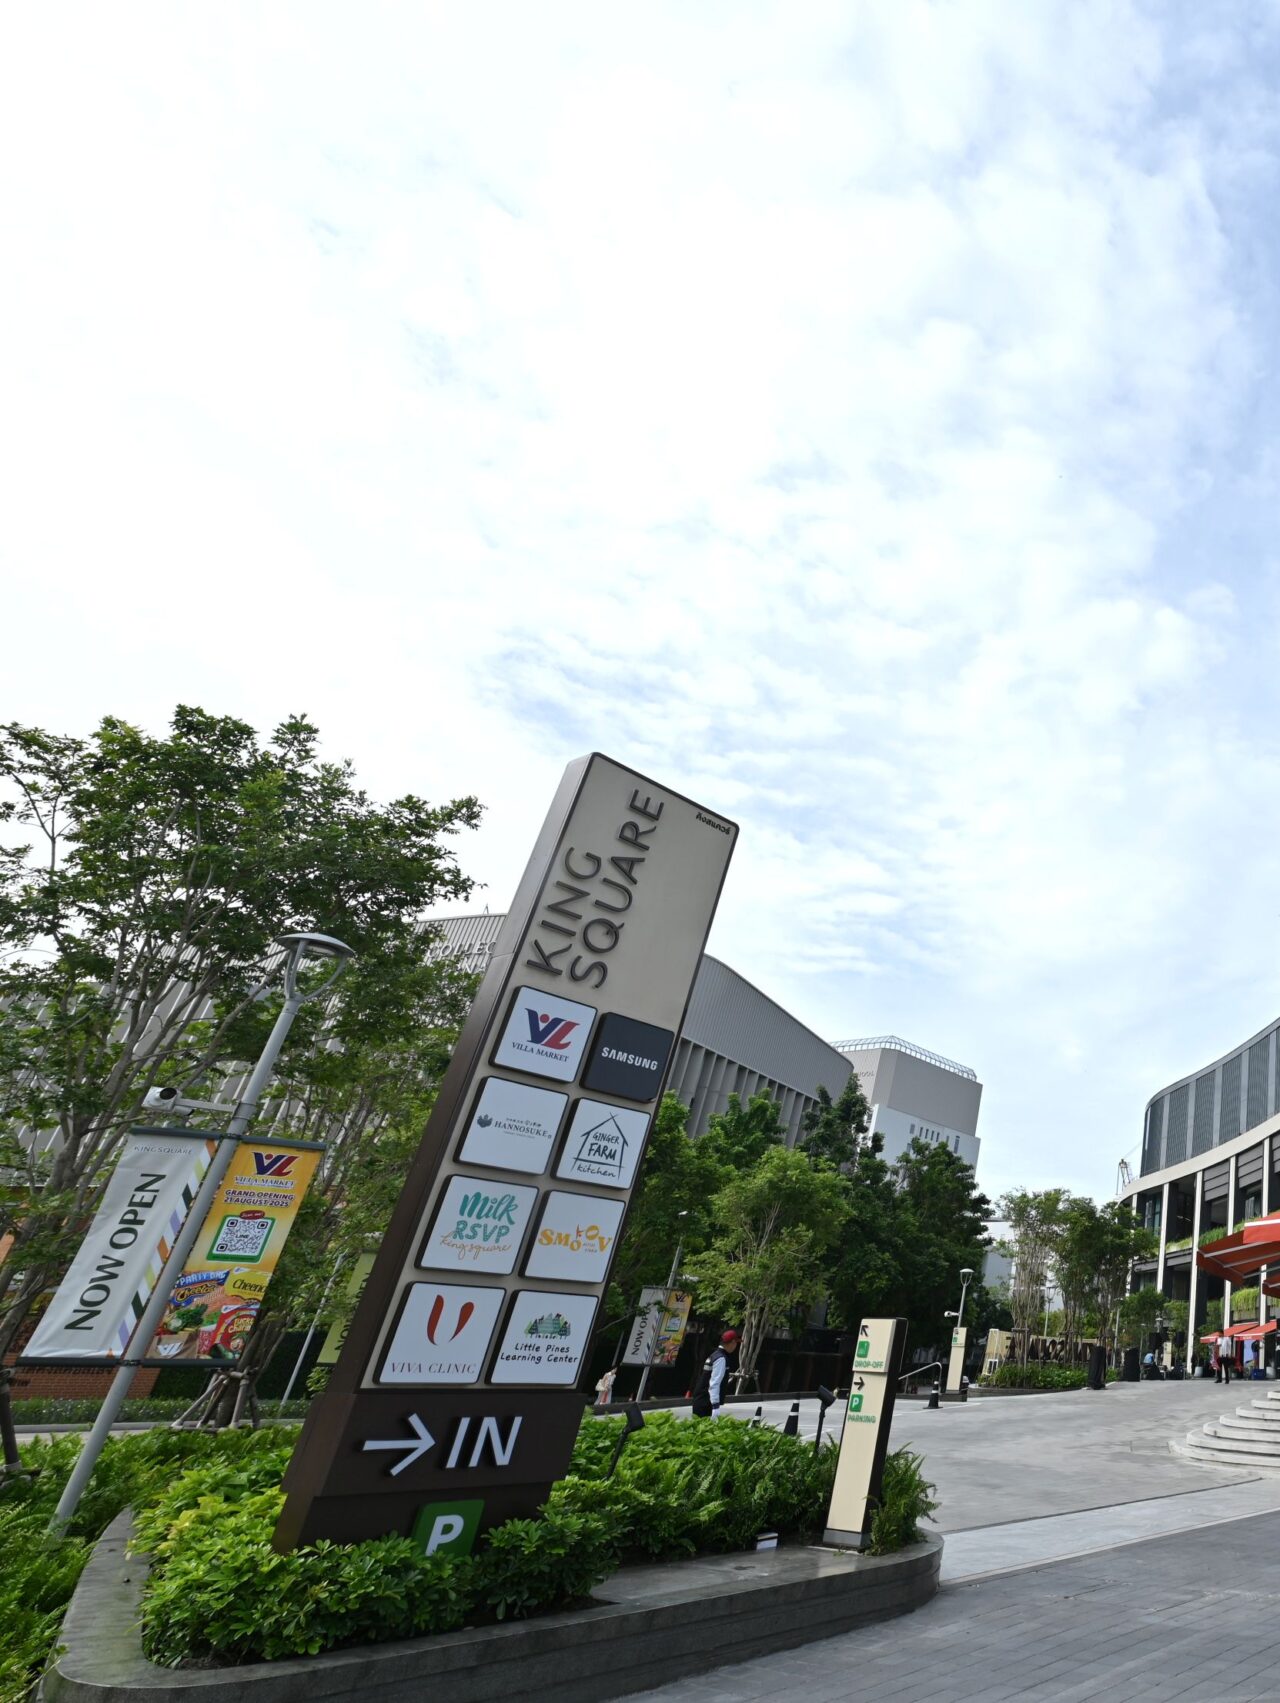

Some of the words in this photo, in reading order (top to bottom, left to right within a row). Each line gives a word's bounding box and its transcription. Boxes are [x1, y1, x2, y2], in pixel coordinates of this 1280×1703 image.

[570, 789, 665, 989] SQUARE
[526, 847, 602, 976] KING
[512, 1041, 534, 1055] VILLA
[535, 1048, 570, 1063] MARKET
[601, 1046, 658, 1071] SAMSUNG
[494, 1120, 549, 1138] HANNOSUKE
[592, 1131, 621, 1145] GINGER
[587, 1142, 617, 1162] FARM
[576, 1161, 617, 1178] kitchen
[225, 1189, 256, 1198] GRAND
[257, 1191, 294, 1200] OPENING
[234, 1197, 268, 1205] AUGUST
[268, 1199, 289, 1207] 2025
[459, 1191, 519, 1226] Milk
[452, 1220, 510, 1243] RSVP
[64, 1255, 125, 1331] NOW
[109, 1173, 167, 1250] OPEN
[180, 1272, 209, 1286] PARTY
[514, 1343, 541, 1352] Little
[545, 1344, 570, 1353] Pines
[631, 1330, 645, 1356] NOW
[500, 1352, 542, 1364] Learning
[547, 1354, 579, 1363] Center
[854, 1360, 885, 1369] DROP-OFF
[391, 1362, 424, 1374] VIVA
[428, 1362, 477, 1374] CLINIC
[851, 1397, 860, 1408] P
[847, 1414, 876, 1424] PARKING
[446, 1416, 523, 1469] IN
[424, 1514, 465, 1557] P
